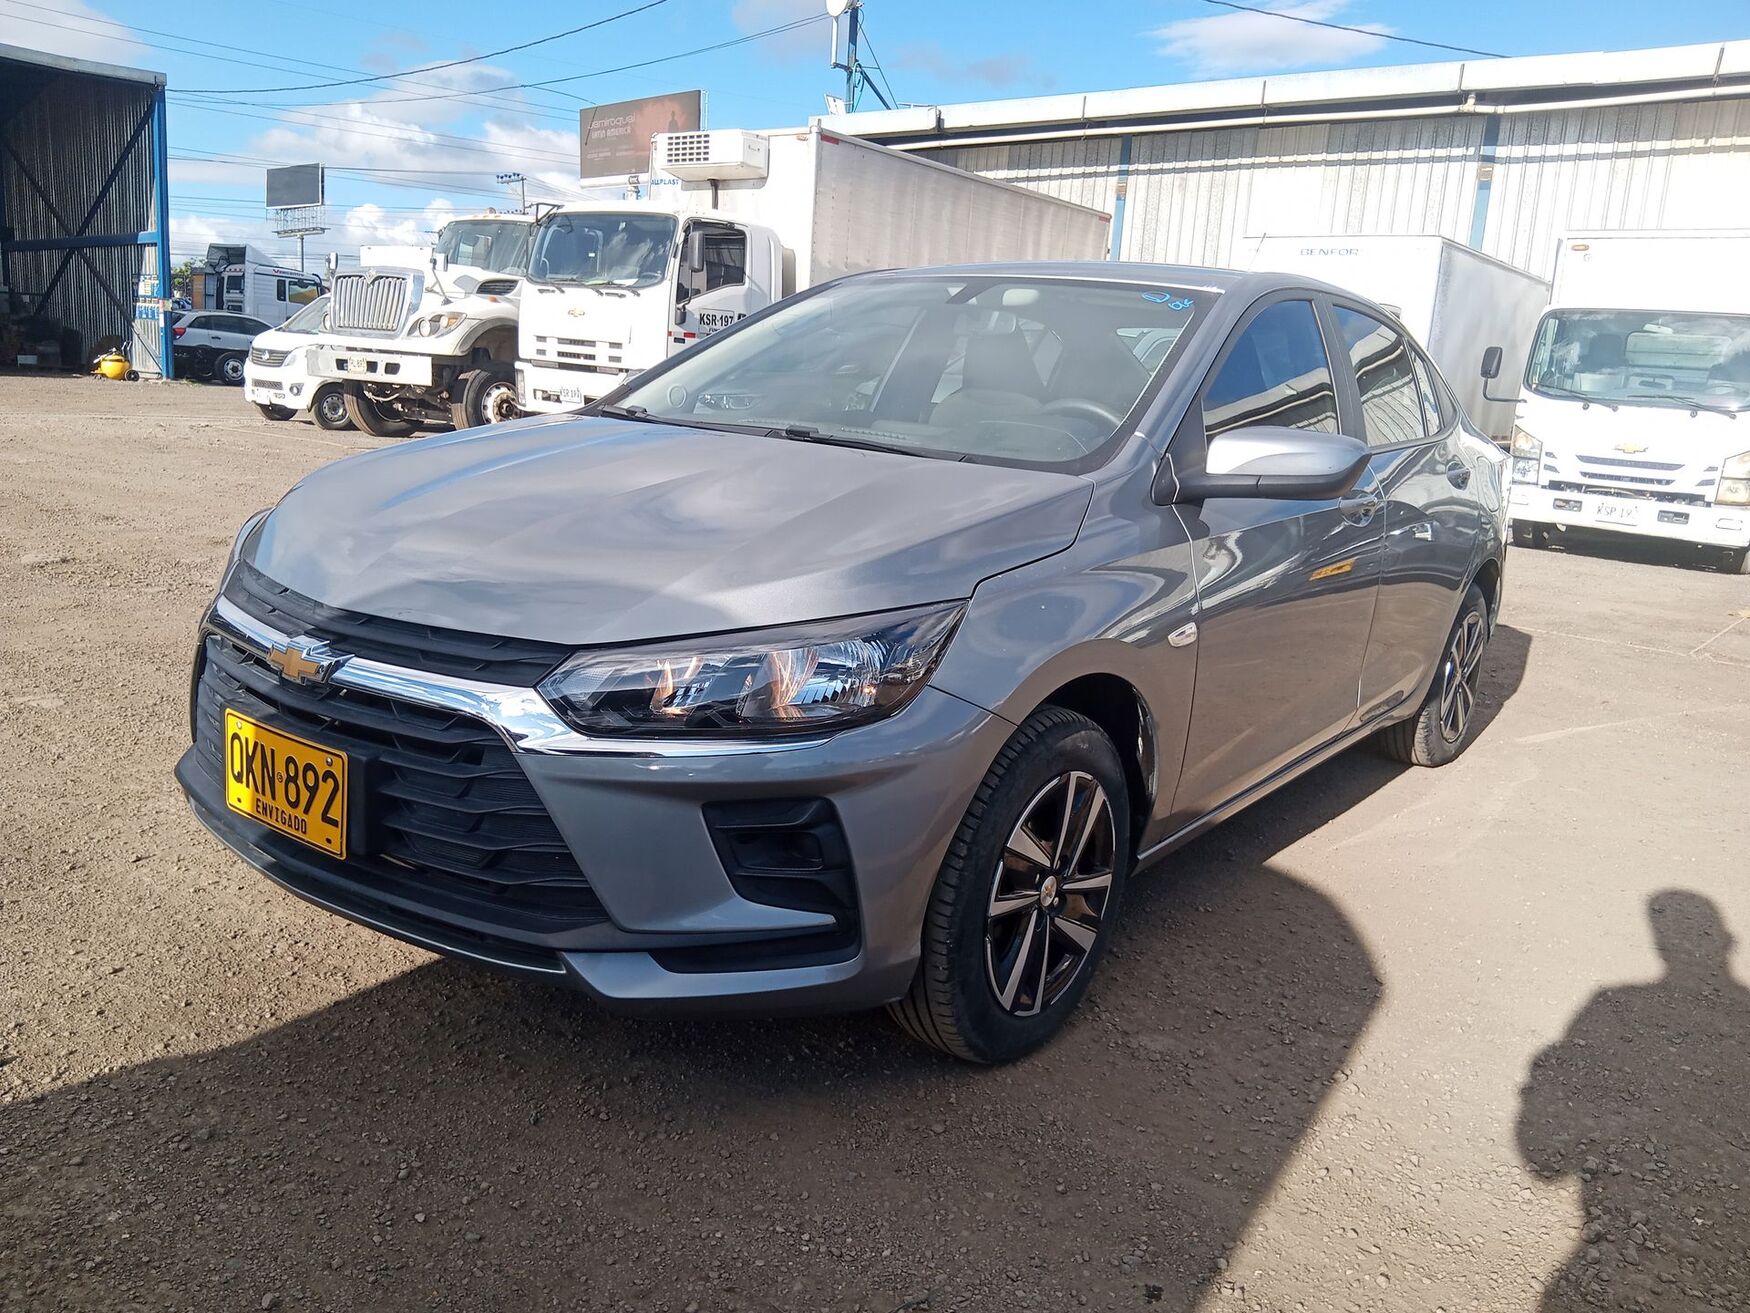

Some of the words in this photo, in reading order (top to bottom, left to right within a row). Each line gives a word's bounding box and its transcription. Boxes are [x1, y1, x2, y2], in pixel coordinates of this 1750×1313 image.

[230, 732, 276, 801] QKN
[284, 755, 340, 829] 892
[255, 798, 307, 835] ENVIGADO
